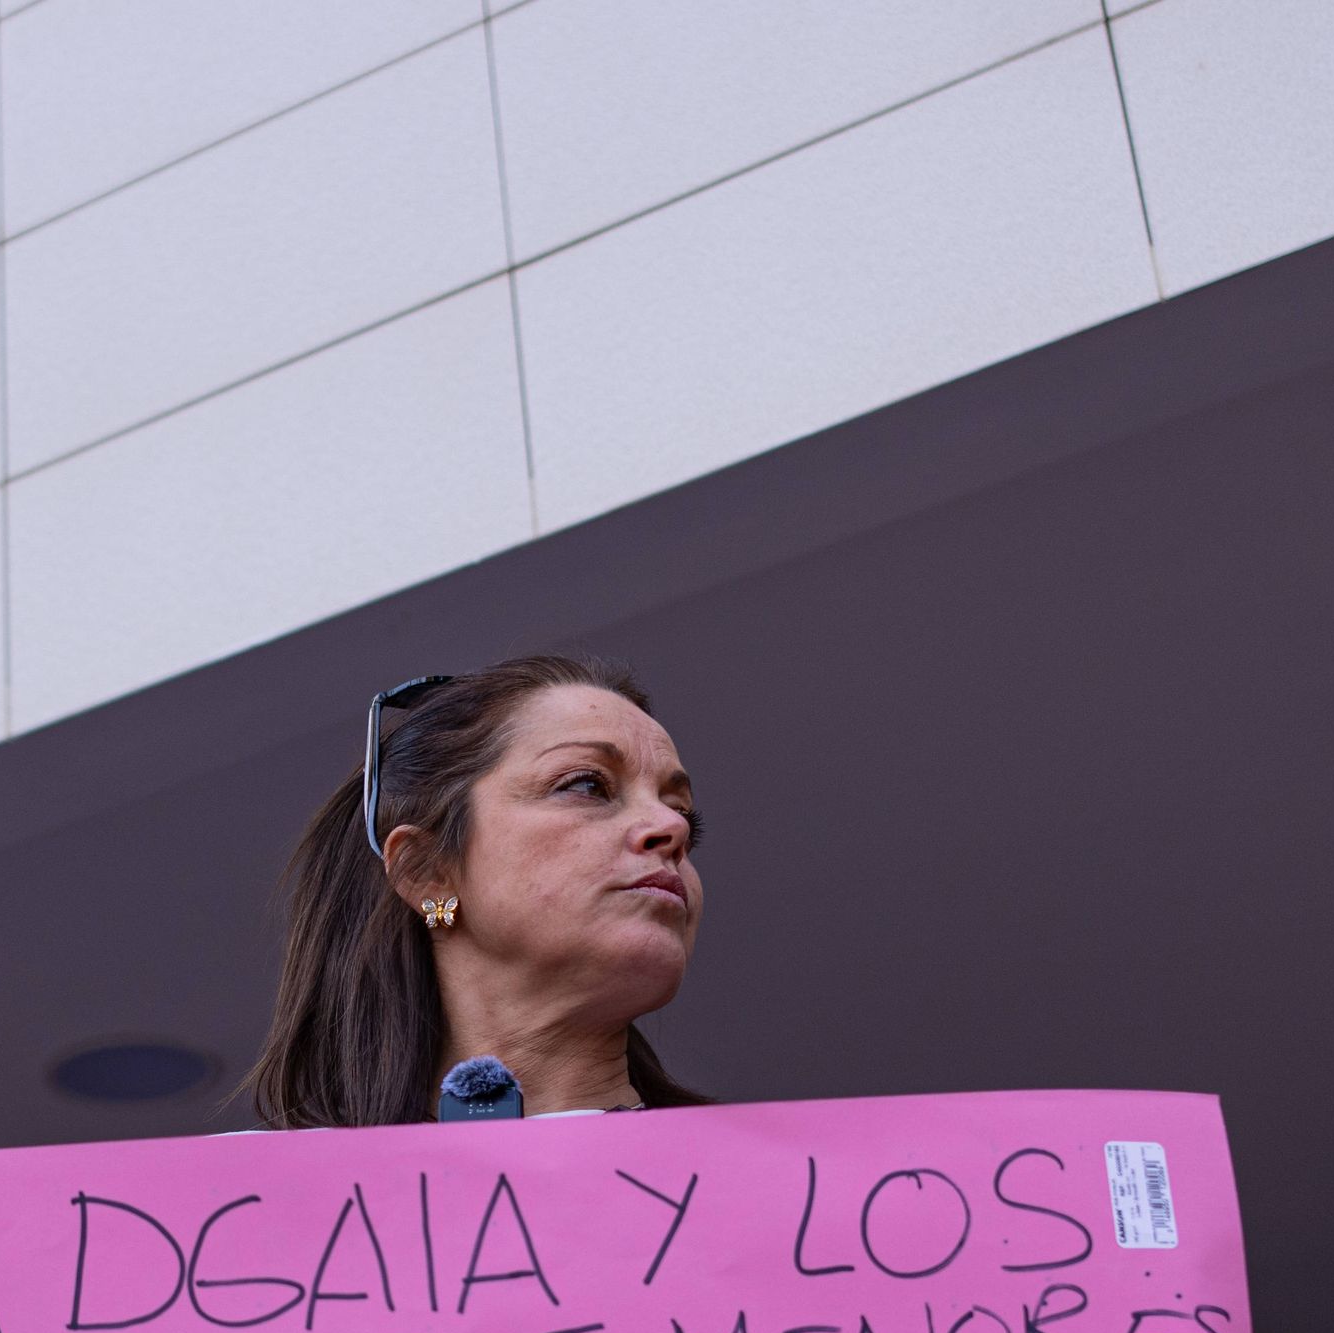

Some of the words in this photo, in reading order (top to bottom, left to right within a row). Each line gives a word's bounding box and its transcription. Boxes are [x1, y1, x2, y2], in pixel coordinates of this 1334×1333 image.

[65, 1172, 560, 1332] DGAIA
[616, 1170, 698, 1286] Y
[793, 1147, 1093, 1280] LOS
